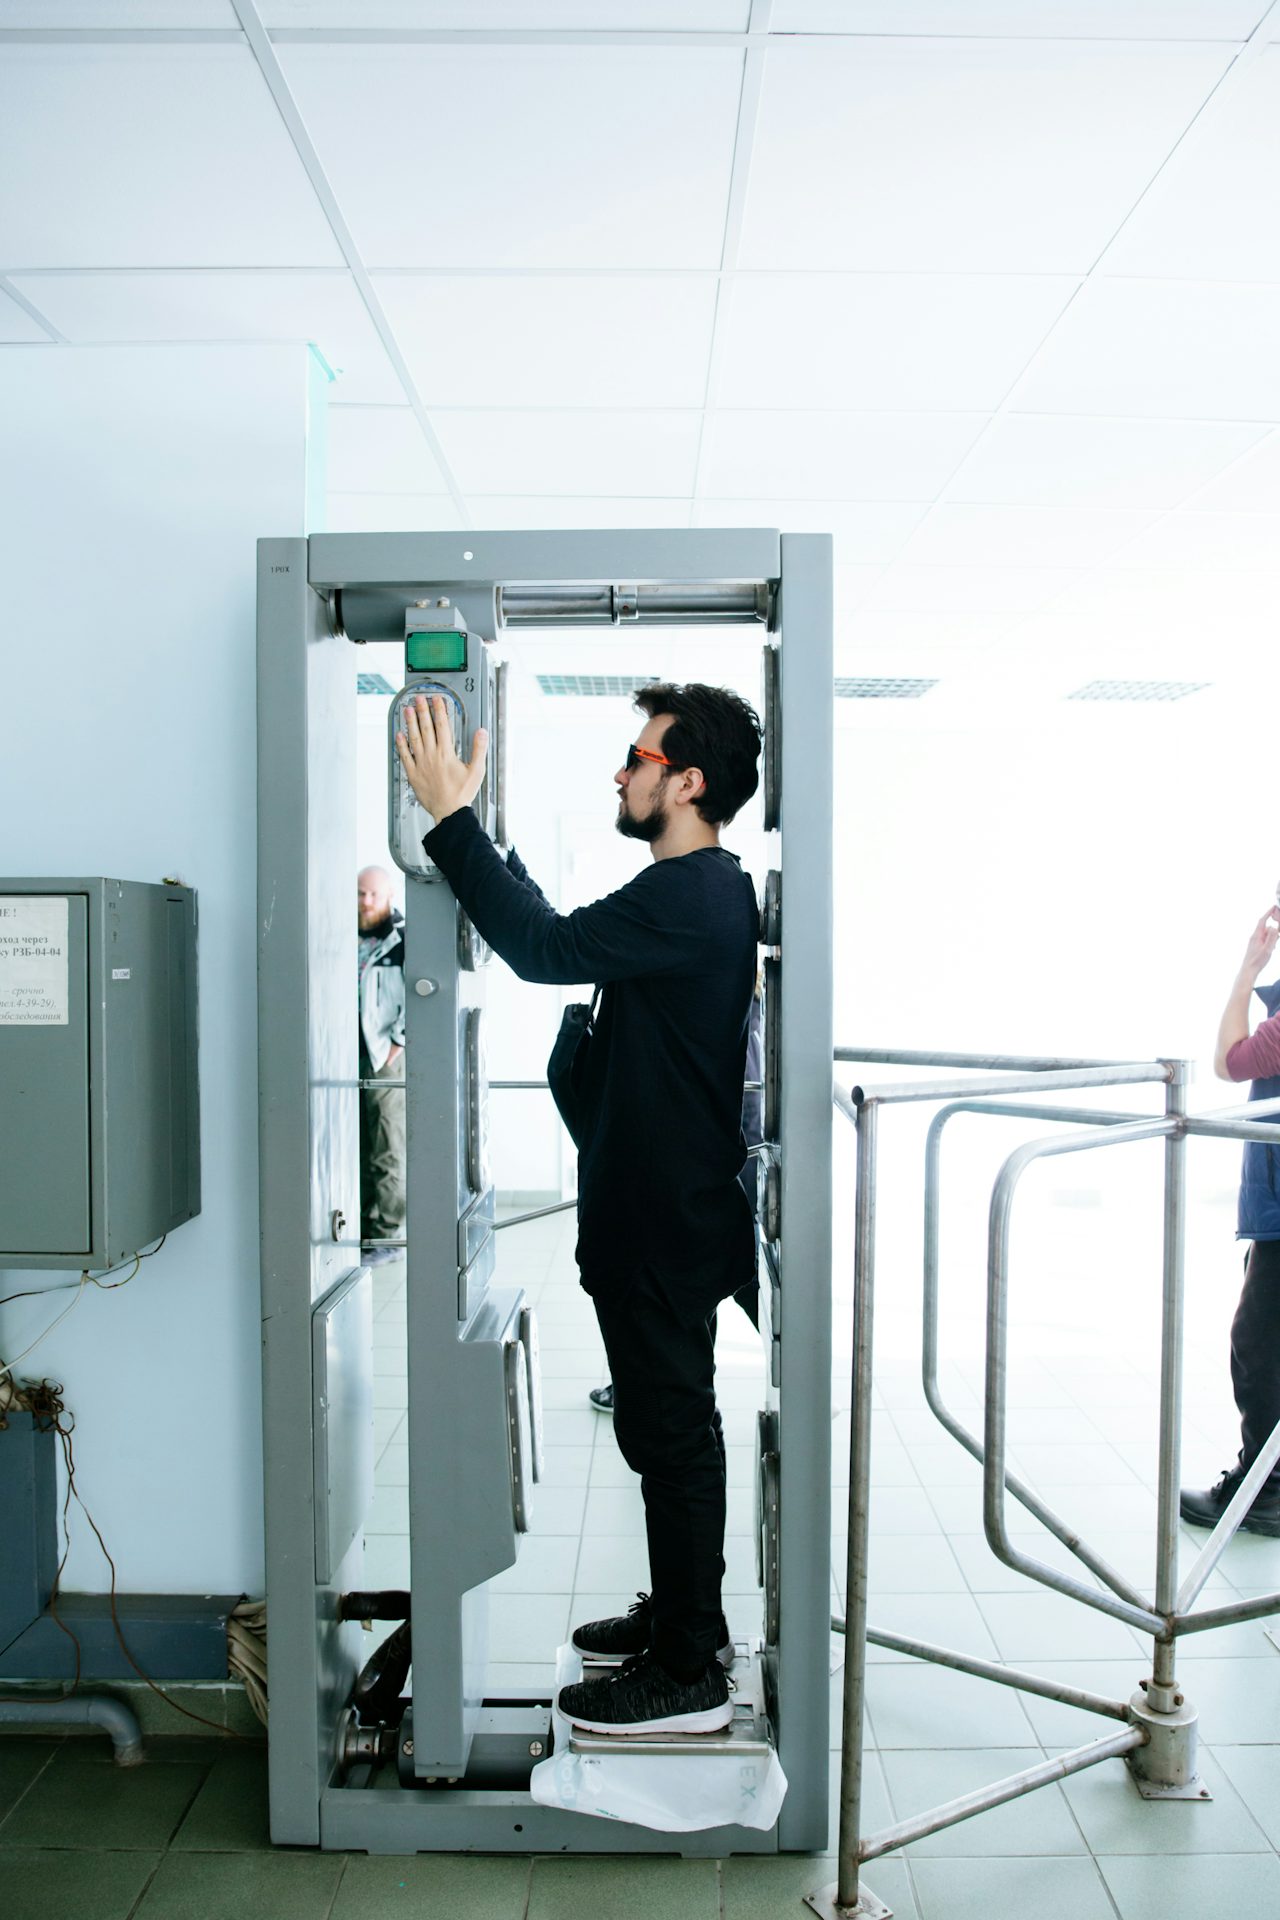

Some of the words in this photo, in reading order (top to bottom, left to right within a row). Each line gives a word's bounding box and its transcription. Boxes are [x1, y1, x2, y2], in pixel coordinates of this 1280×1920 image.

[465, 677, 474, 692] 8
[22, 937, 48, 945] через
[11, 987, 45, 997] срочно
